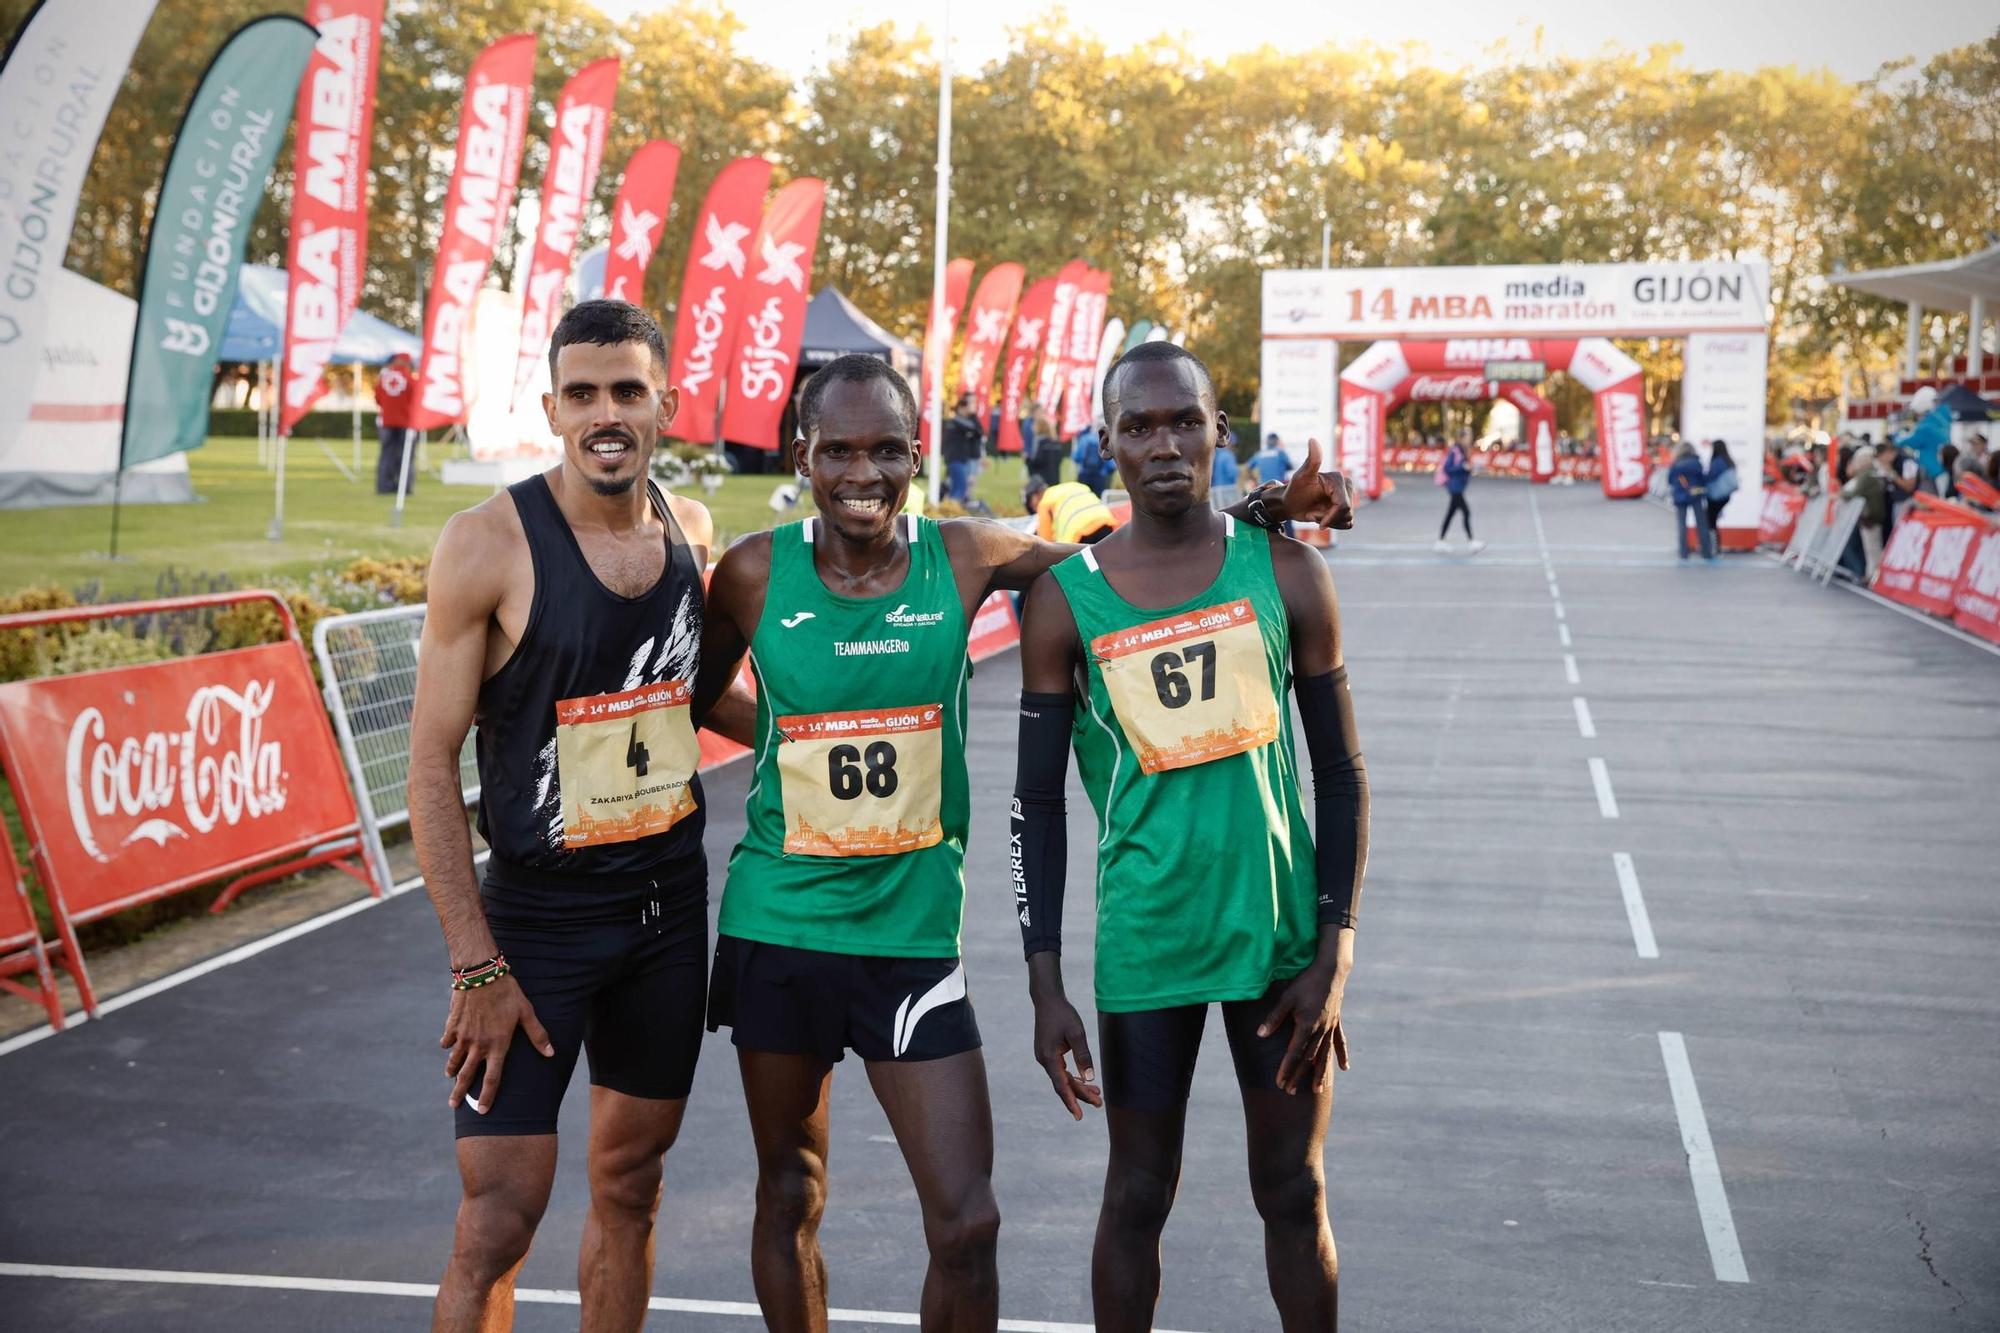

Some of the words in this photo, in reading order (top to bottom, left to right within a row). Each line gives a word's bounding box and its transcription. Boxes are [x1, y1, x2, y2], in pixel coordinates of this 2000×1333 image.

[305, 13, 359, 211] MBA
[455, 83, 510, 246] MBA
[543, 103, 592, 255] MBA
[1505, 275, 1585, 298] media
[1634, 267, 1742, 303] GIJÓN
[287, 226, 340, 407] MBA
[1346, 287, 1397, 322] 14
[1409, 296, 1492, 320] MBA
[1504, 299, 1616, 321] maratón
[422, 260, 487, 416] MBA
[1141, 626, 1174, 643] MBA
[1200, 612, 1231, 628] GIJÓN
[834, 639, 909, 656] TEAMMANAGER10
[1150, 640, 1217, 709] 67
[608, 700, 635, 713] MBA
[647, 690, 672, 703] GIJÓN
[825, 720, 858, 731] MBA
[886, 714, 919, 728] GIJÓN
[626, 721, 650, 777] 4
[66, 680, 289, 863] Coca-Cola
[828, 741, 898, 800] 68
[591, 793, 634, 804] ZAKARIYA
[1010, 832, 1027, 905] TERREX
